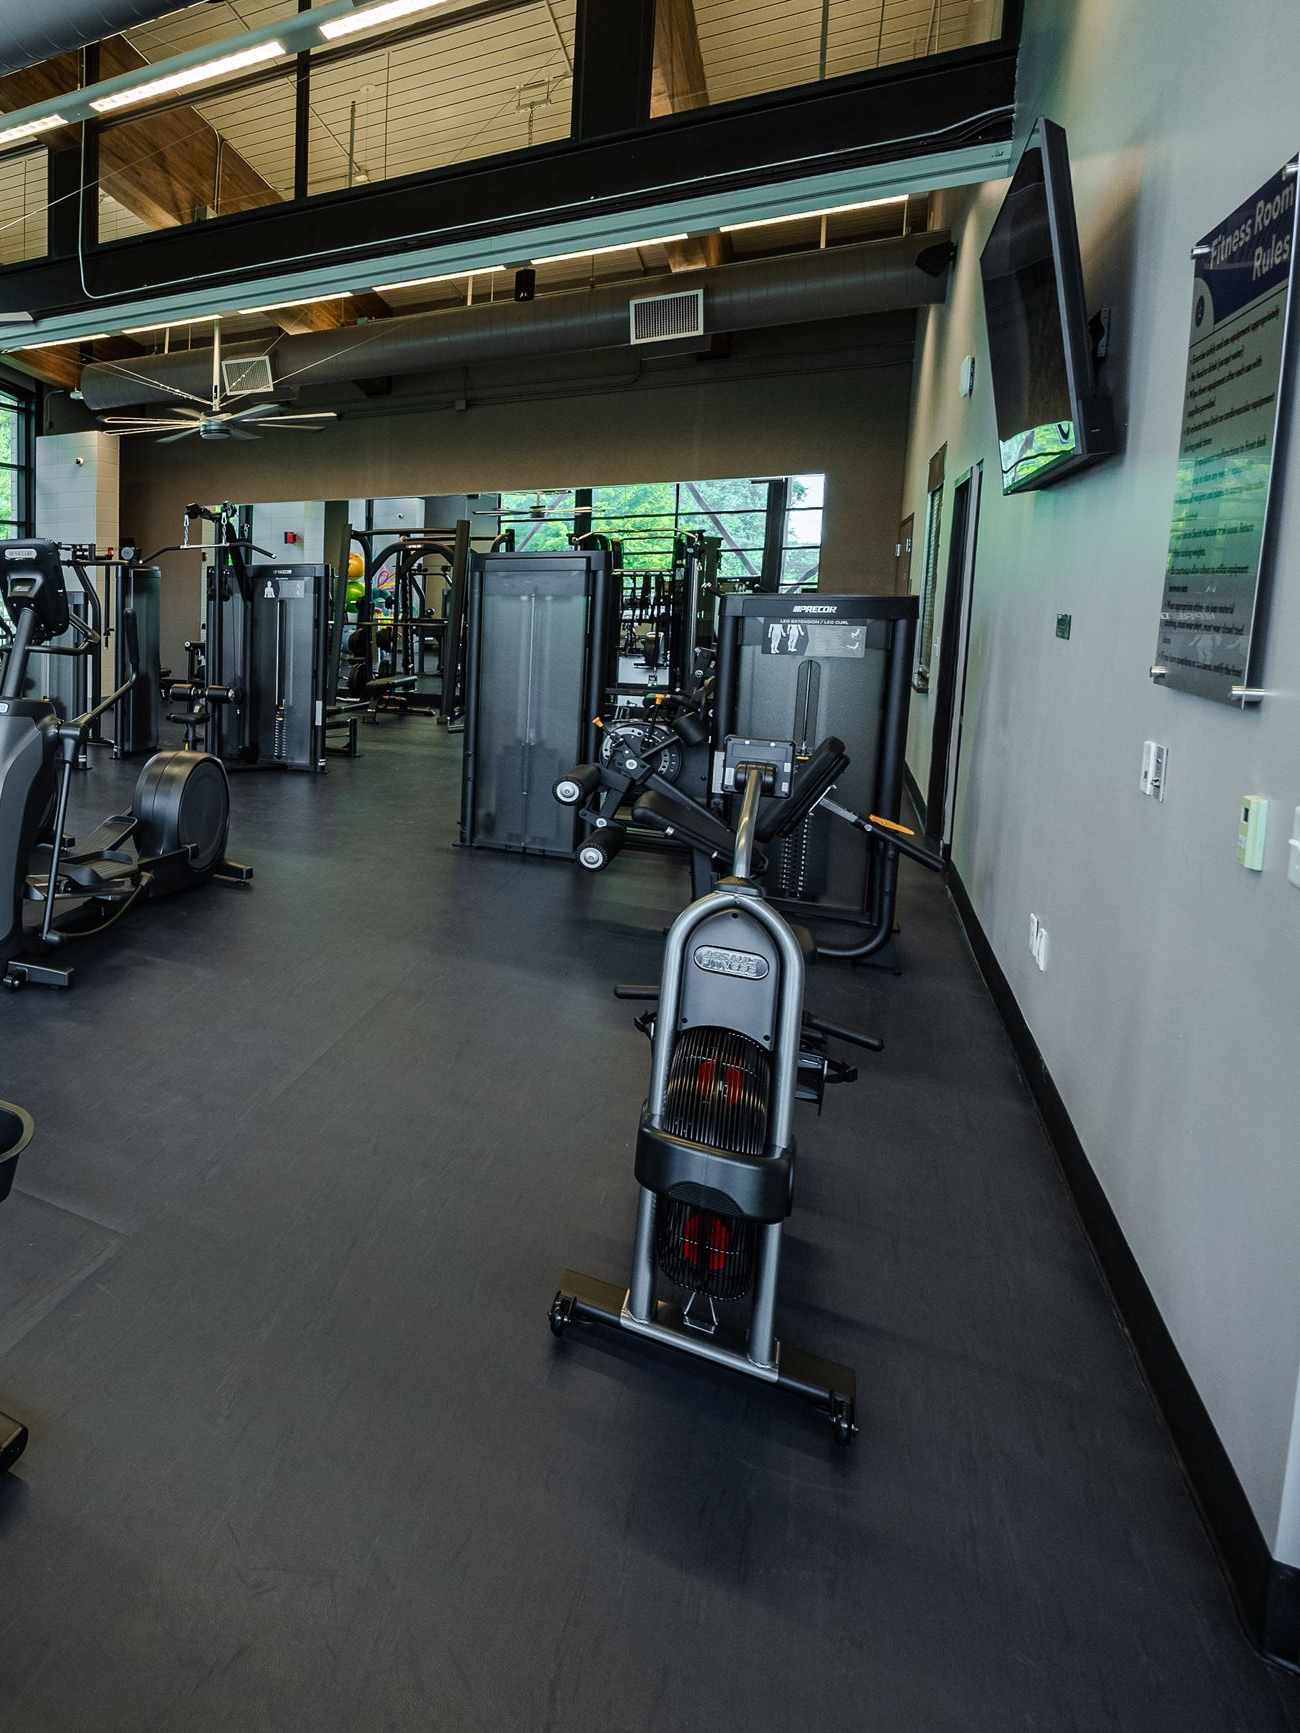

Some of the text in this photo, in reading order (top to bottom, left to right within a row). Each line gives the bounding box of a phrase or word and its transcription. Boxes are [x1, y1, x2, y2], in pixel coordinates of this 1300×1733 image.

[1210, 182, 1294, 269] Fitness Room
[1252, 234, 1290, 281] Rules
[798, 605, 838, 614] PRECOR
